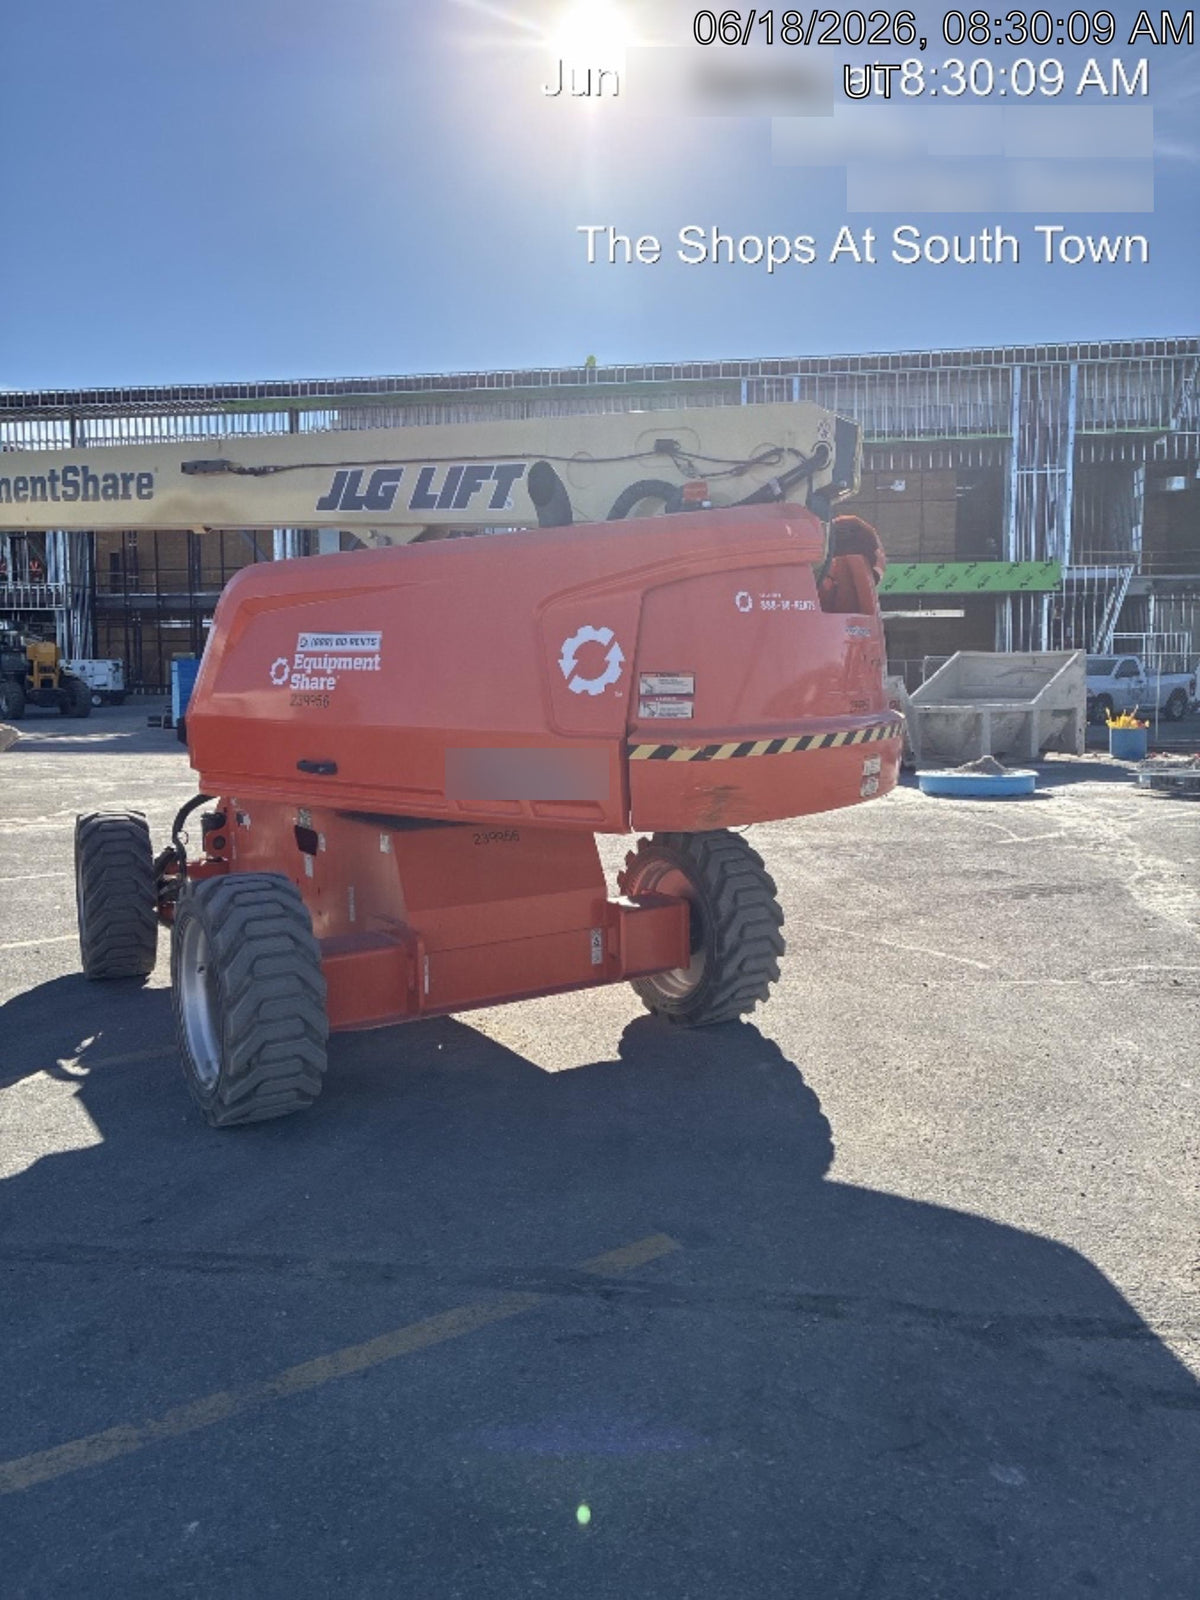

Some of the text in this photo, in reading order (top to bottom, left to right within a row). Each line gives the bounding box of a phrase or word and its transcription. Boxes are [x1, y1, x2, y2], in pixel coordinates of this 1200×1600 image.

[314, 462, 529, 512] JLG LIFT
[293, 653, 382, 675] Equipment
[289, 673, 337, 691] Share
